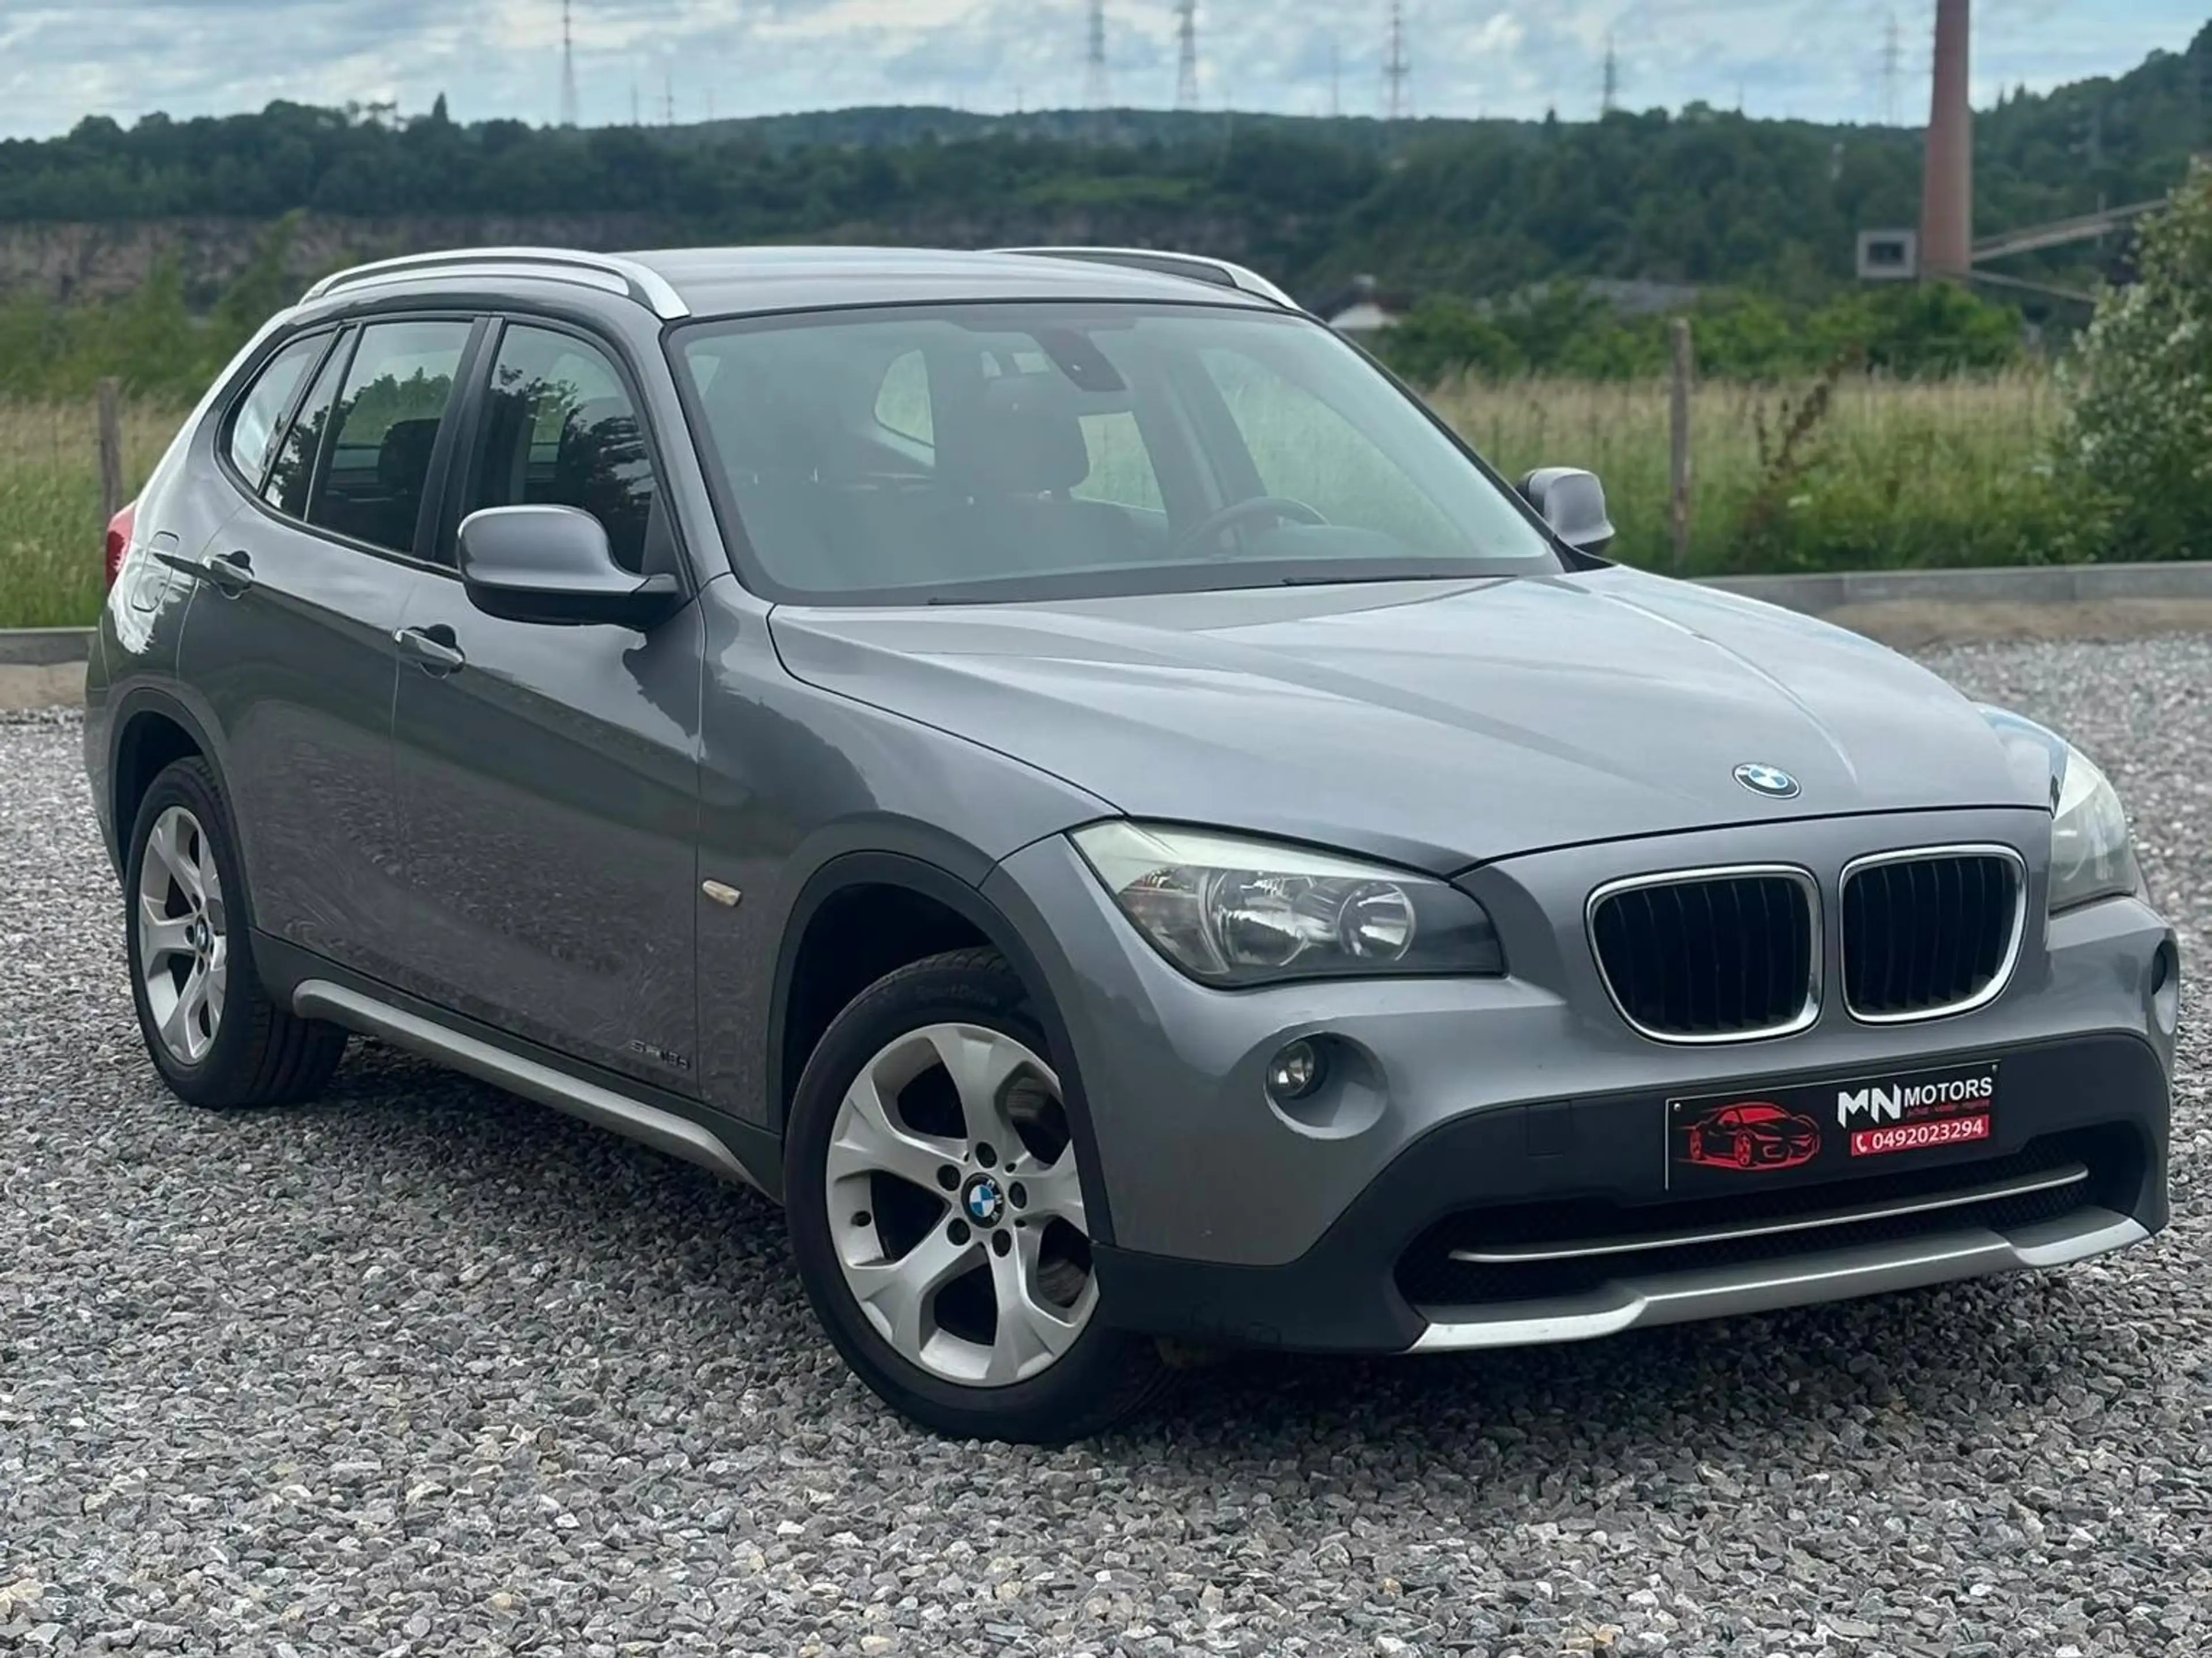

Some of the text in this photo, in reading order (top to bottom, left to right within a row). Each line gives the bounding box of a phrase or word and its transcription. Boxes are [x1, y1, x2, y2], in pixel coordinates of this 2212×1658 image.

[1838, 1084, 1902, 1129] MN
[1904, 1077, 1993, 1107] MOTORS
[1872, 1119, 1984, 1149] 0492023294
